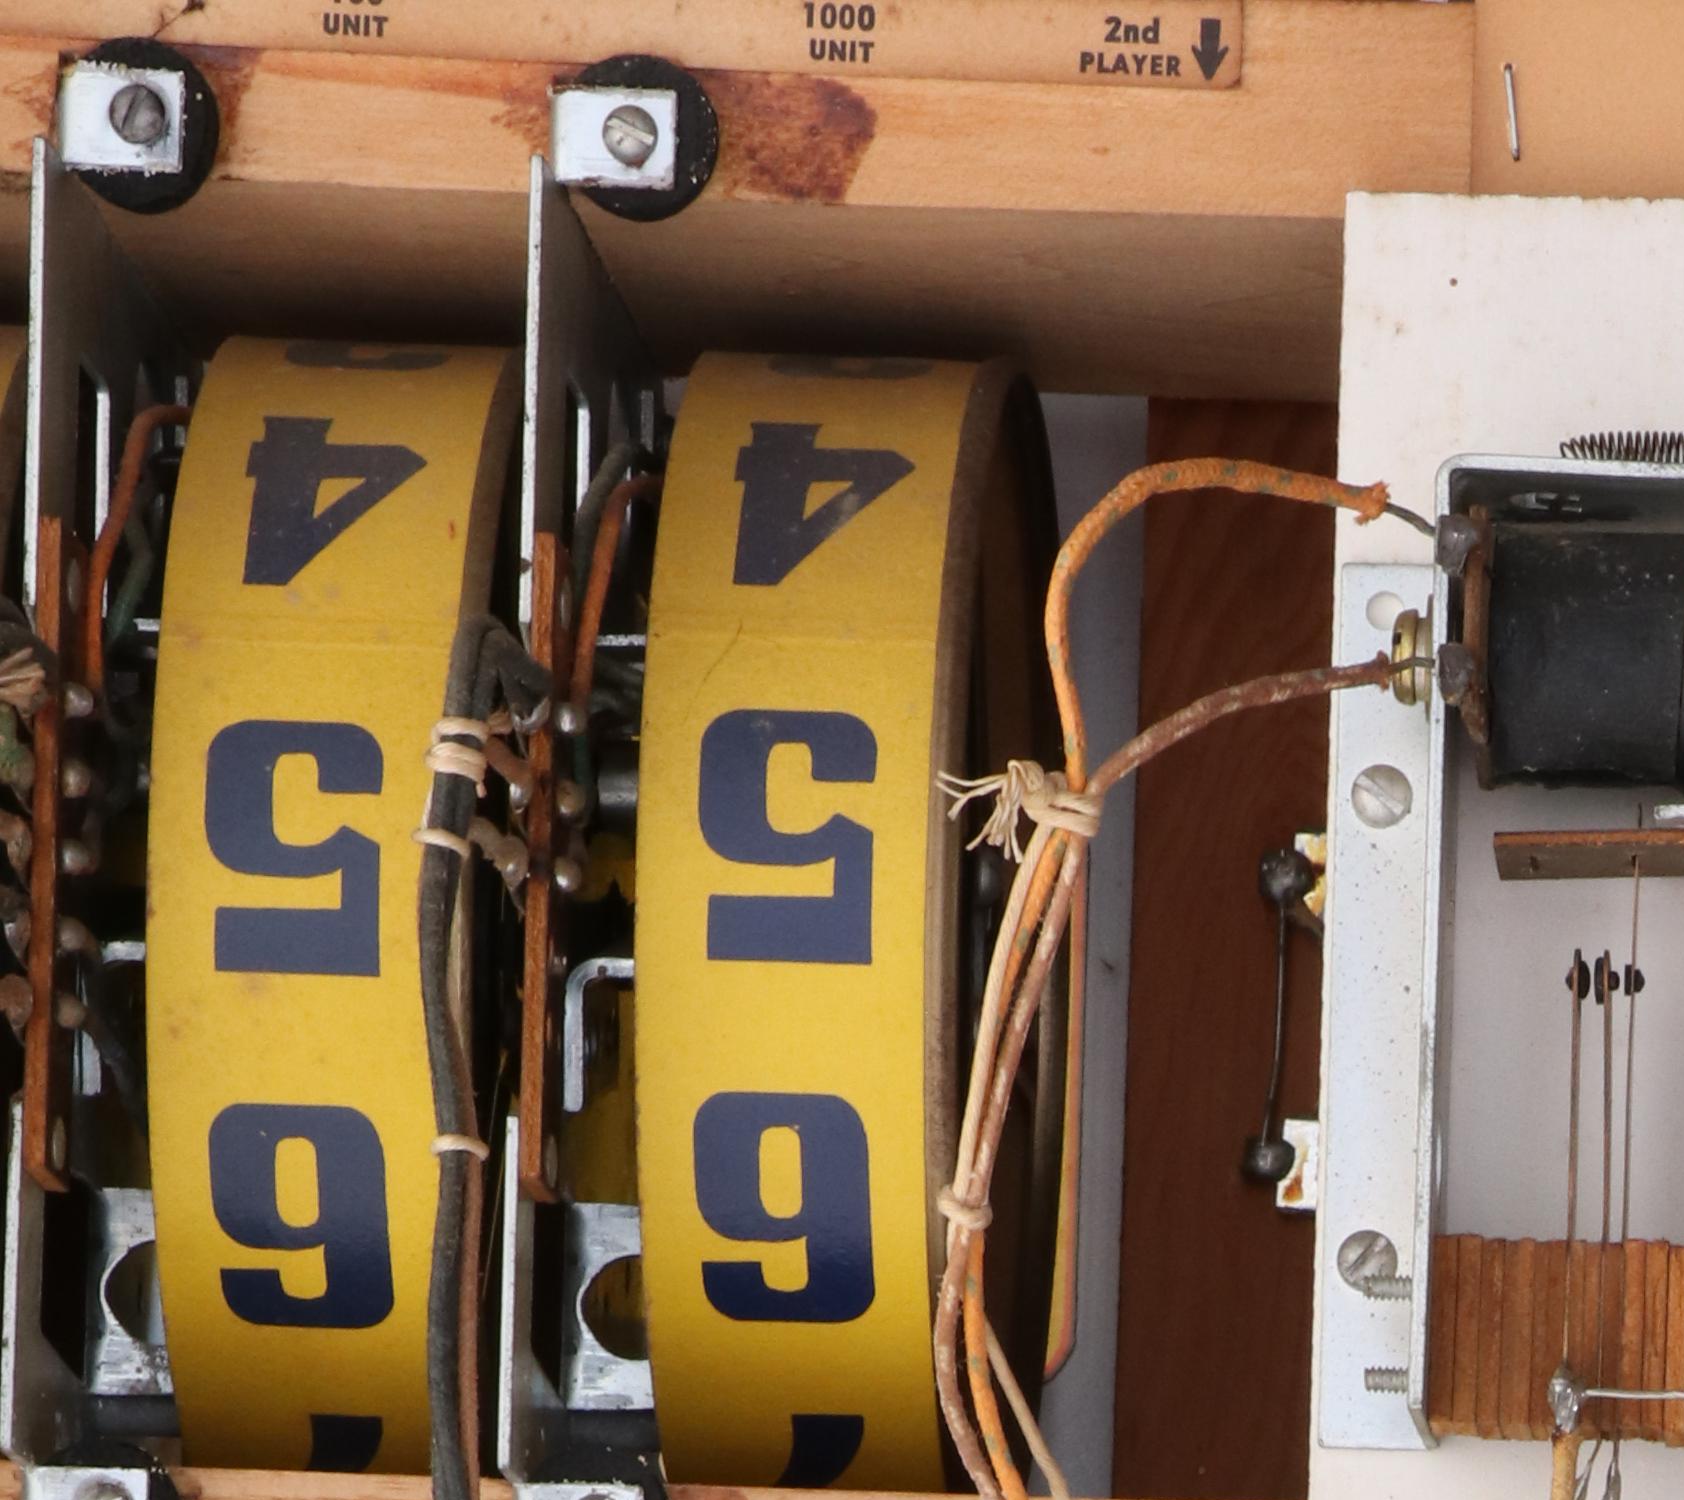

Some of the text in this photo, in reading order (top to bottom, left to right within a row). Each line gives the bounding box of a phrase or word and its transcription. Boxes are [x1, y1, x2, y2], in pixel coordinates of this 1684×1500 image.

[322, 12, 389, 38] UNIT
[803, 1, 876, 32] 1000
[1103, 15, 1161, 45] 2nd
[809, 38, 875, 64] UNIT
[1079, 51, 1182, 78] PLAYER
[243, 416, 426, 587] 4
[734, 423, 915, 587] 4
[206, 721, 383, 976] 5
[699, 709, 877, 965] 5
